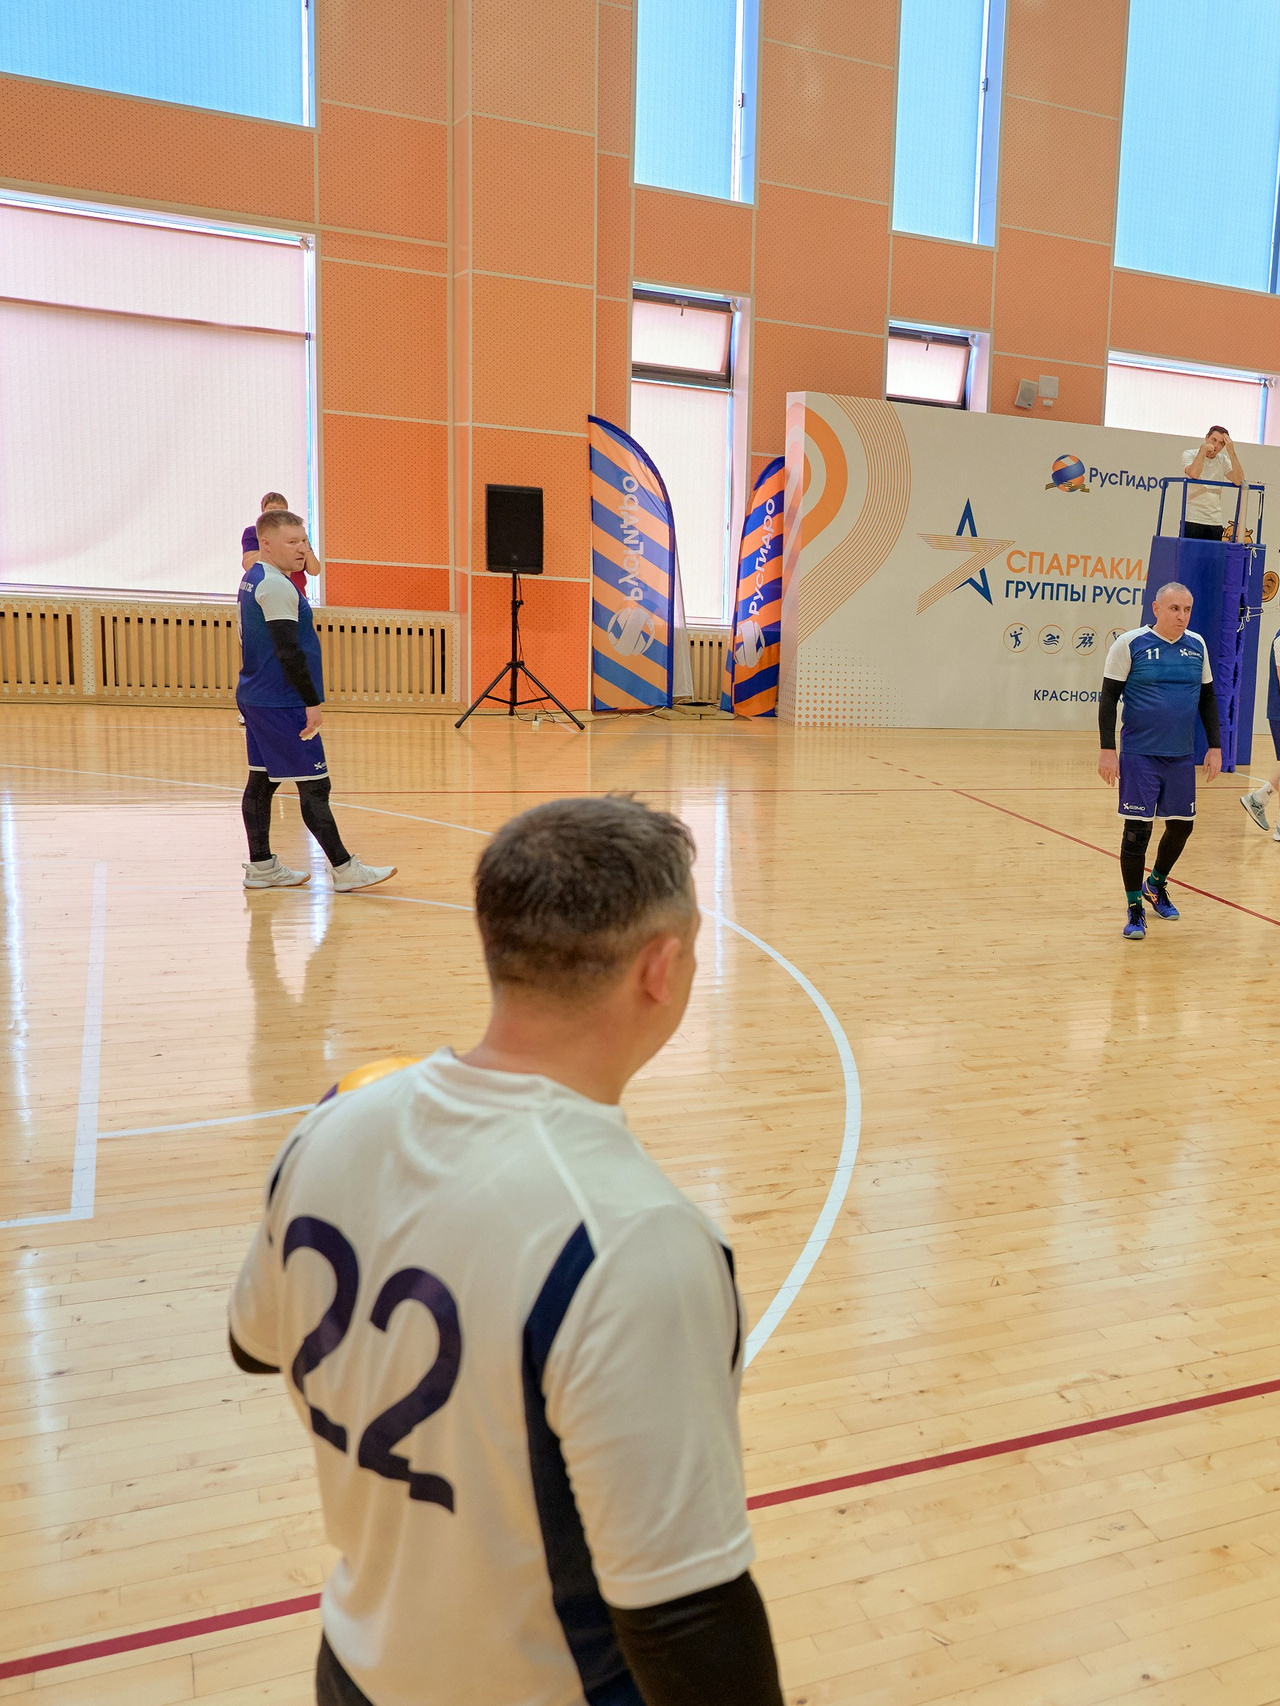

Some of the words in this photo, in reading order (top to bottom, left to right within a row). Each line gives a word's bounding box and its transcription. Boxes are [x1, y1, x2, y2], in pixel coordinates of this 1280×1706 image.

[748, 498, 775, 616] РУСГИДРО
[1006, 549, 1149, 581] СПАРТАКИ
[1005, 579, 1086, 603] ГРУППЫ
[1145, 647, 1160, 660] 11
[1033, 689, 1121, 703] КРАСНОЯ
[283, 1214, 462, 1515] 22
